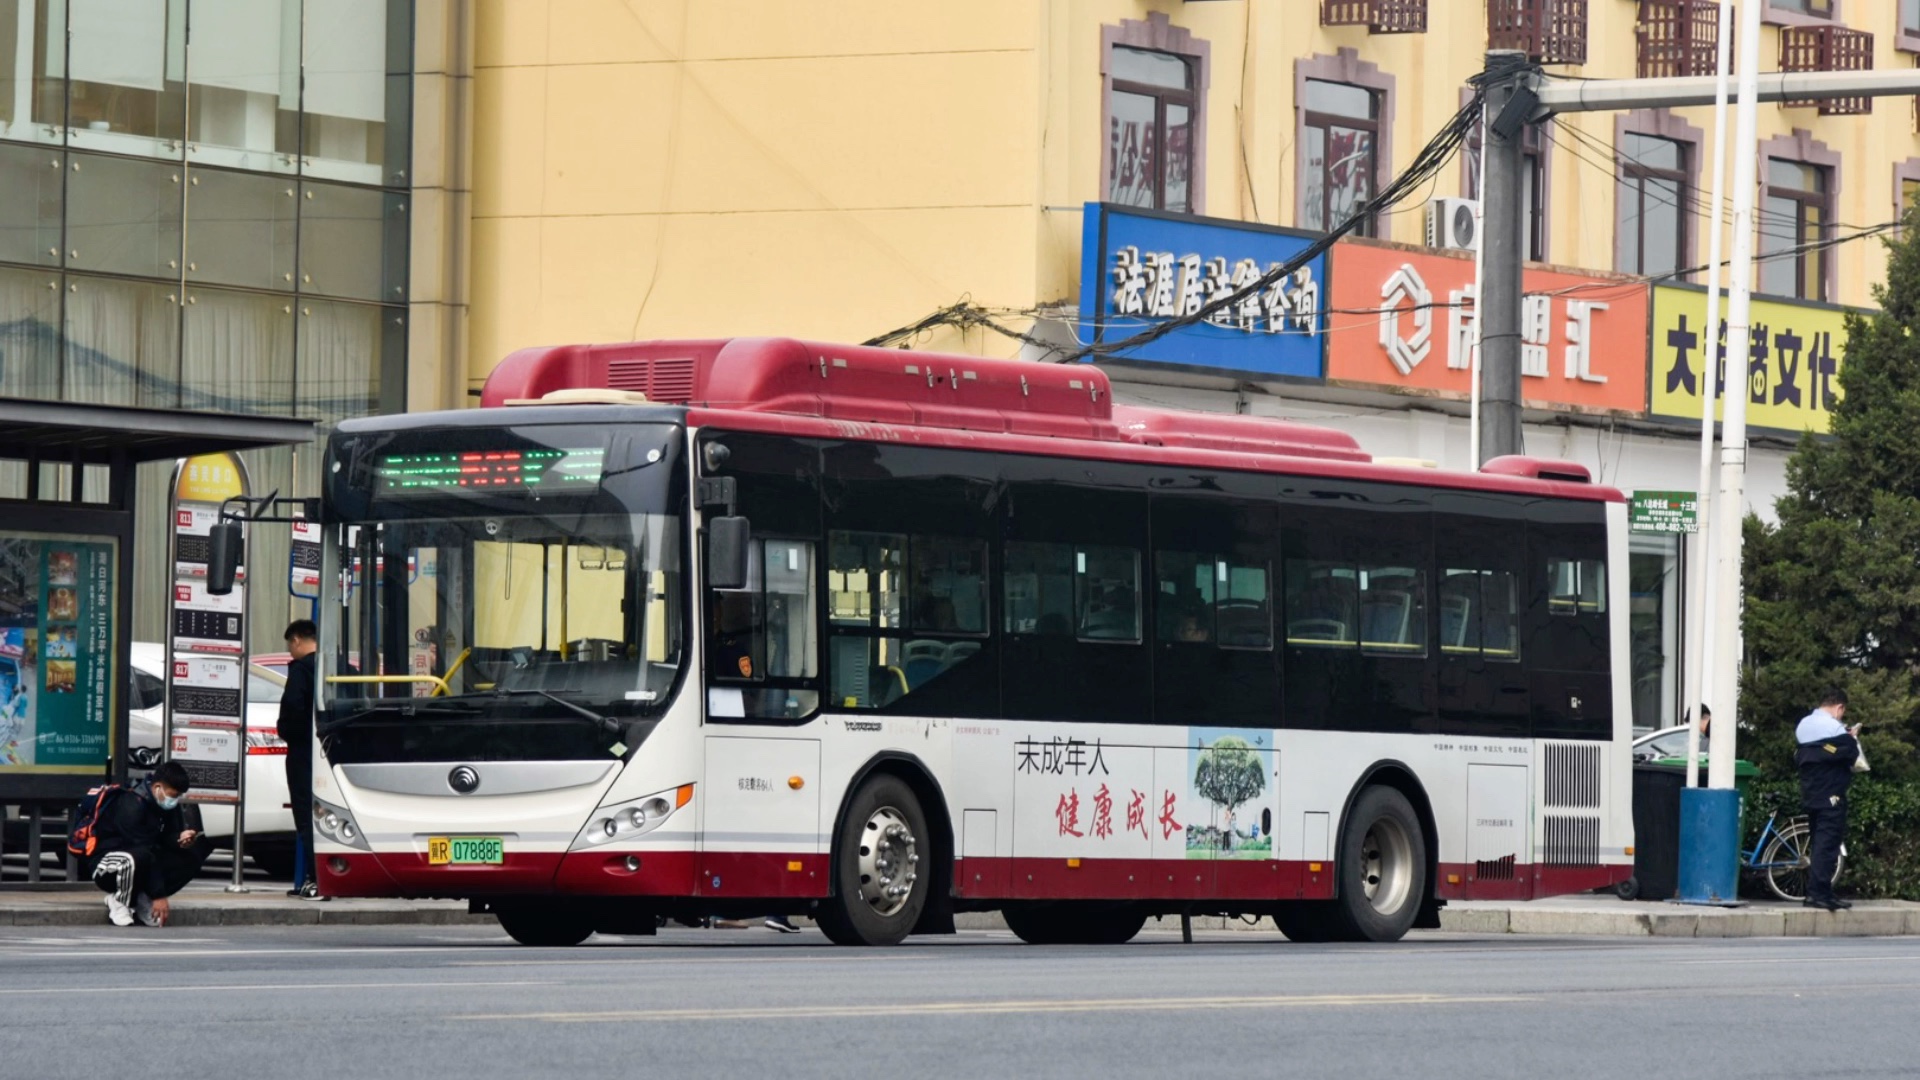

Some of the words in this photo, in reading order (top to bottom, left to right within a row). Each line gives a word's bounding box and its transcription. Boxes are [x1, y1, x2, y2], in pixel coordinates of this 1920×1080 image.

[1018, 734, 1110, 776] 未成年人
[1055, 782, 1183, 841] 健康成长
